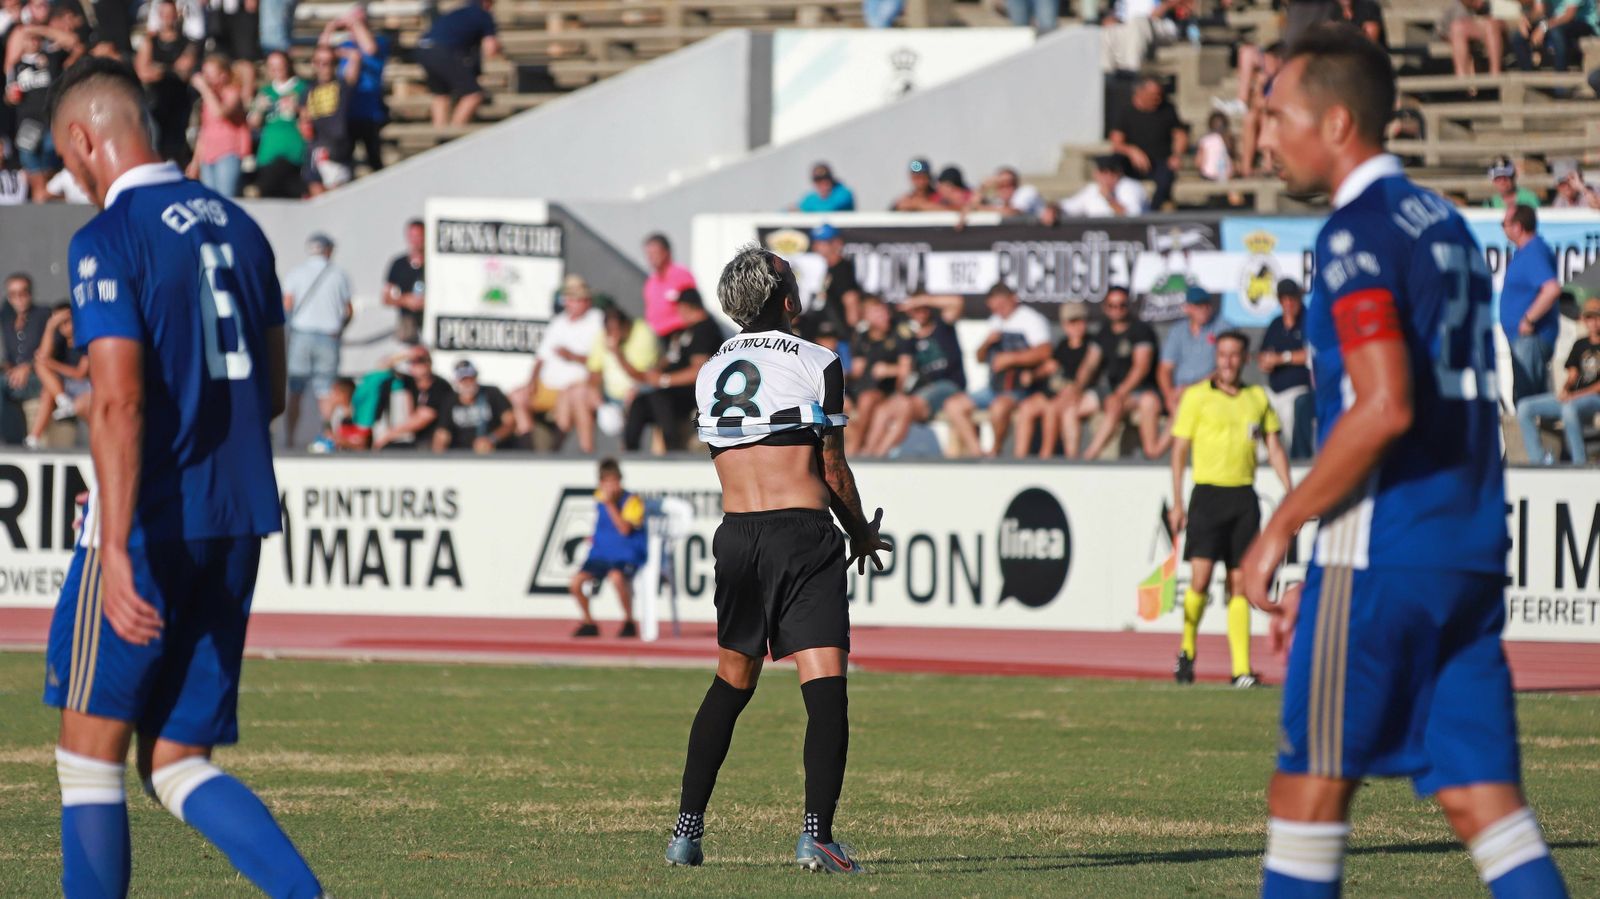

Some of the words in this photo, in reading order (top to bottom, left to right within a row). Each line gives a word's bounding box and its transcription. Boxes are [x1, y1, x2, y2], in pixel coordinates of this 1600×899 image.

[200, 242, 252, 380] 6
[740, 337, 800, 356] MOLINA
[710, 359, 762, 417] 8
[304, 488, 460, 519] PINTURAS
[304, 528, 464, 588] MATA
